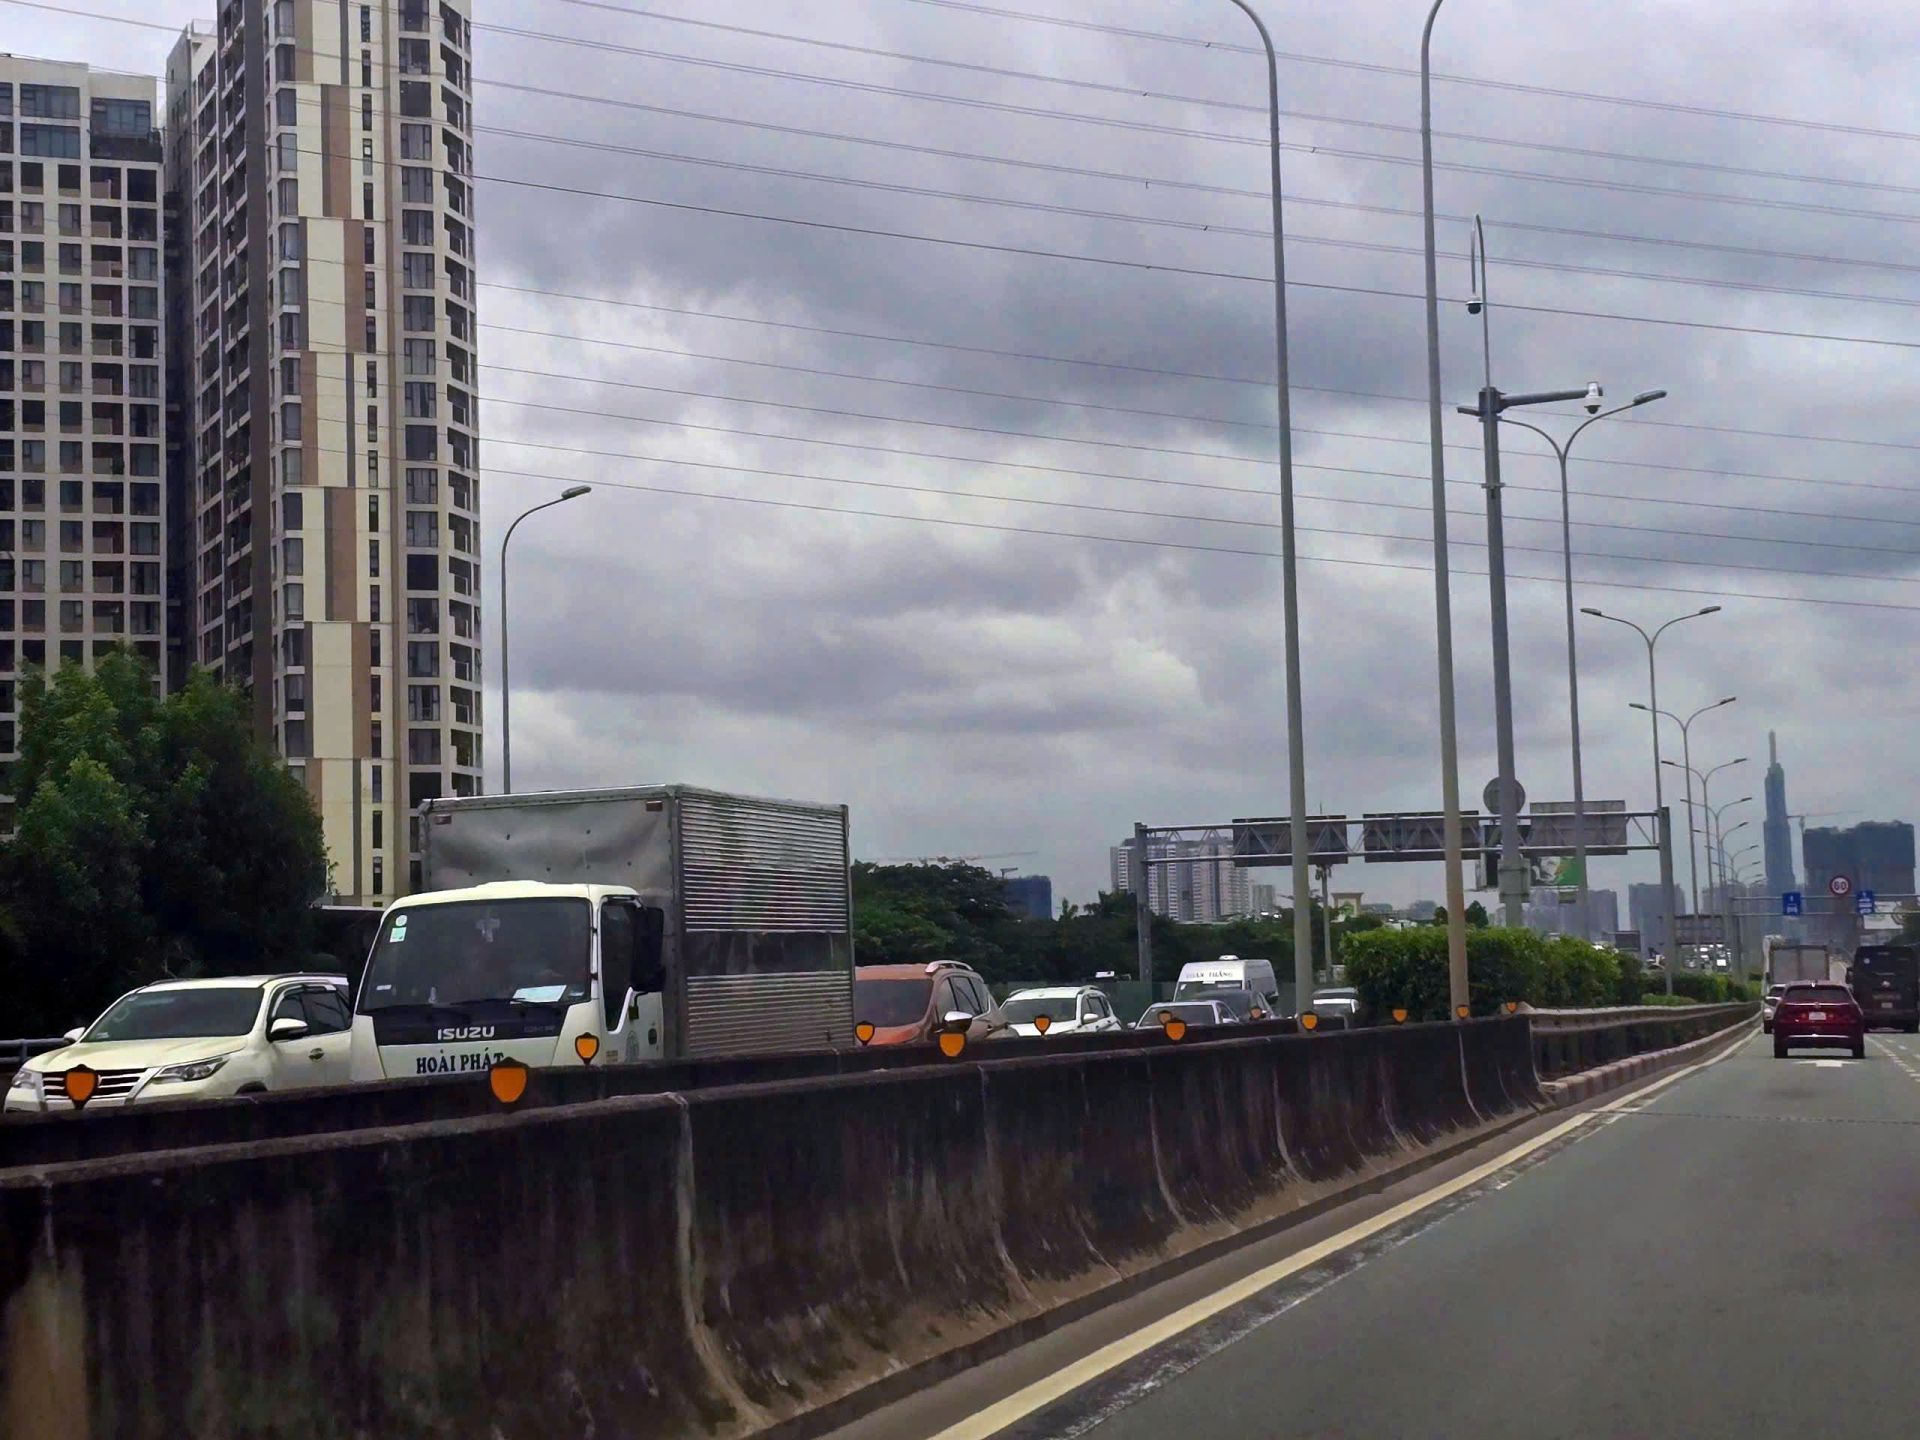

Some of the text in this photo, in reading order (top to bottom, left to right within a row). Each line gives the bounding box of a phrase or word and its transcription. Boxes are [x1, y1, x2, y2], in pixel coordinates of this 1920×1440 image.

[437, 1026, 495, 1040] ISUZU
[416, 1047, 504, 1074] HOÀI PHÁT
